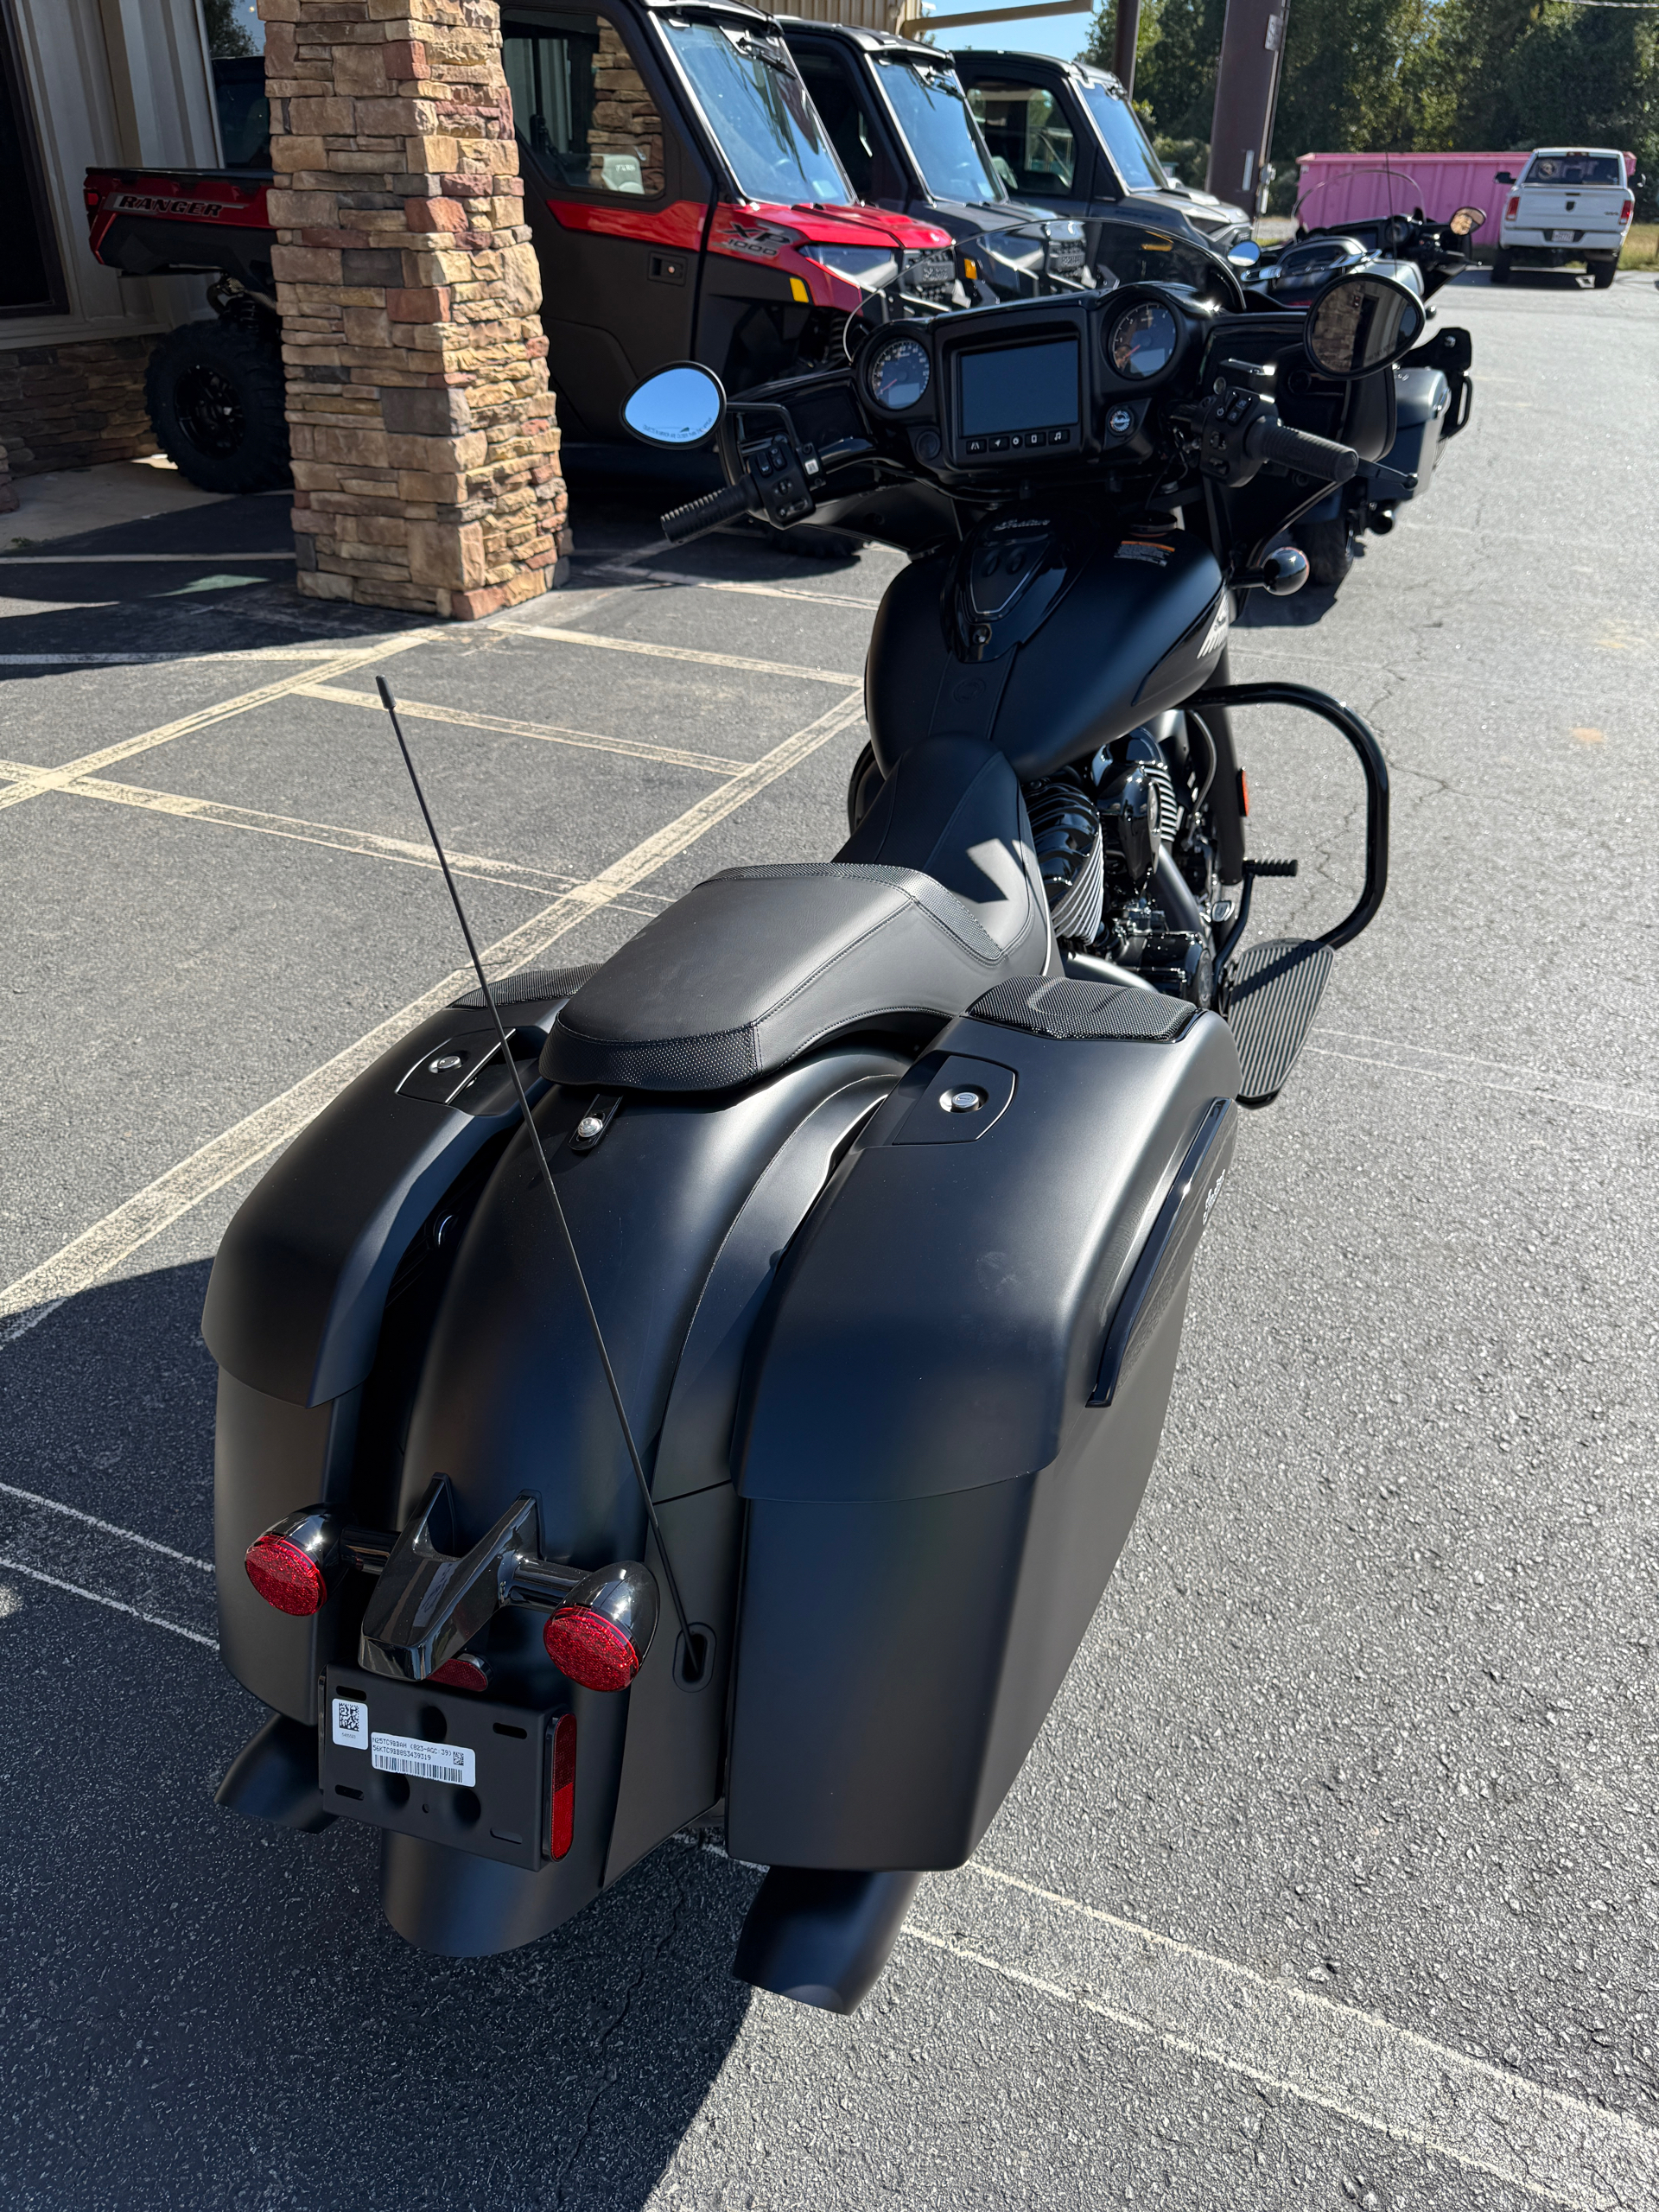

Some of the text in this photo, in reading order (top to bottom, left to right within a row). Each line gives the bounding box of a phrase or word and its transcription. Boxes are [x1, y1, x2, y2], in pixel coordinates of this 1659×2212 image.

[118, 195, 223, 216] RANGER
[719, 222, 791, 244] XP
[728, 238, 778, 256] 1000
